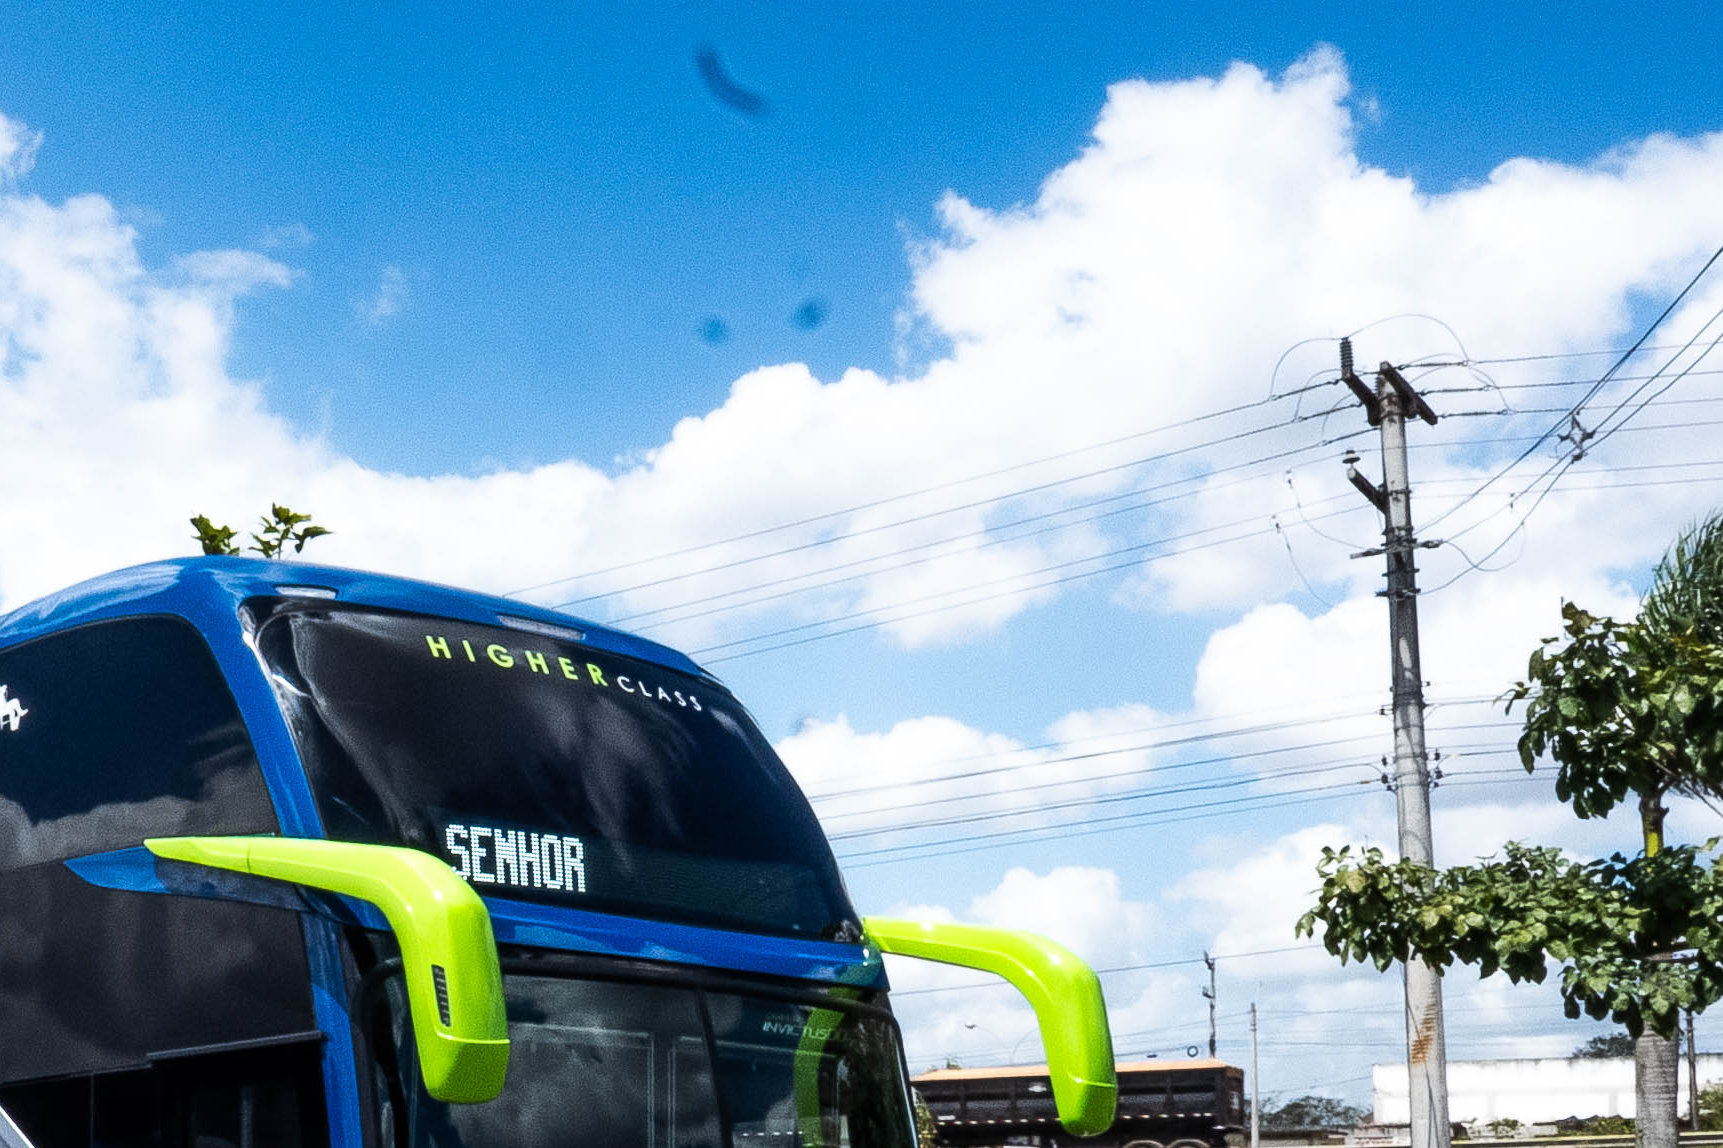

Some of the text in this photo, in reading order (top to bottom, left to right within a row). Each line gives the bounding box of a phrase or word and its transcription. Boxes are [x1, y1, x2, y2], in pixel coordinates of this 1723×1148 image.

[425, 635, 703, 712] HIGHER CLASS
[445, 824, 587, 893] SENHOR
